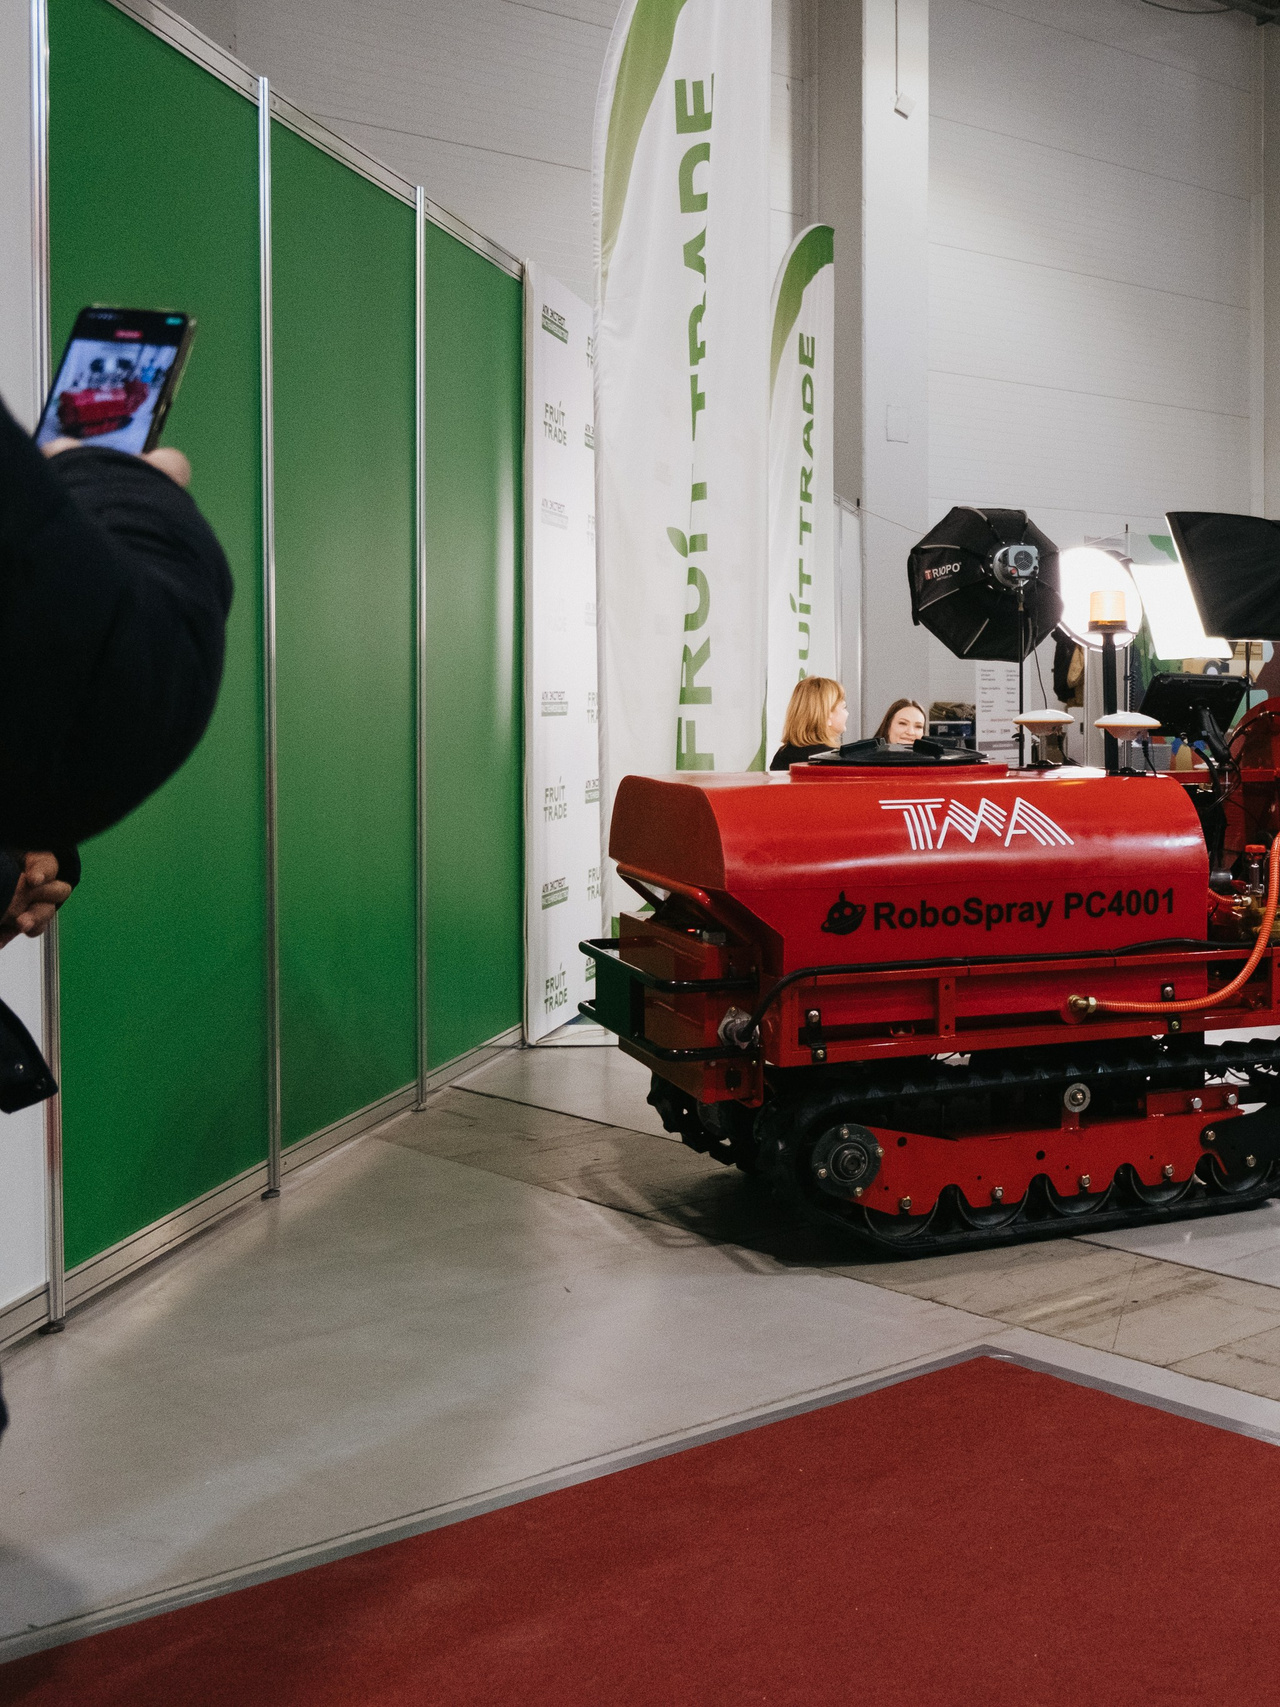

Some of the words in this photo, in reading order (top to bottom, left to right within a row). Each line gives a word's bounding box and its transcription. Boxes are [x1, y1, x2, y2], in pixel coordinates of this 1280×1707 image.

[674, 72, 715, 442] TRADE
[543, 420, 567, 446] TRADE
[798, 333, 816, 546] TRADE
[924, 563, 960, 580] TRIOPO
[789, 558, 813, 683] UIT
[544, 803, 567, 822] TRADE
[879, 797, 1075, 850] TMA
[873, 897, 1053, 931] RoboSpray
[1063, 888, 1174, 919] PC4001
[544, 988, 567, 1014] TRADE
